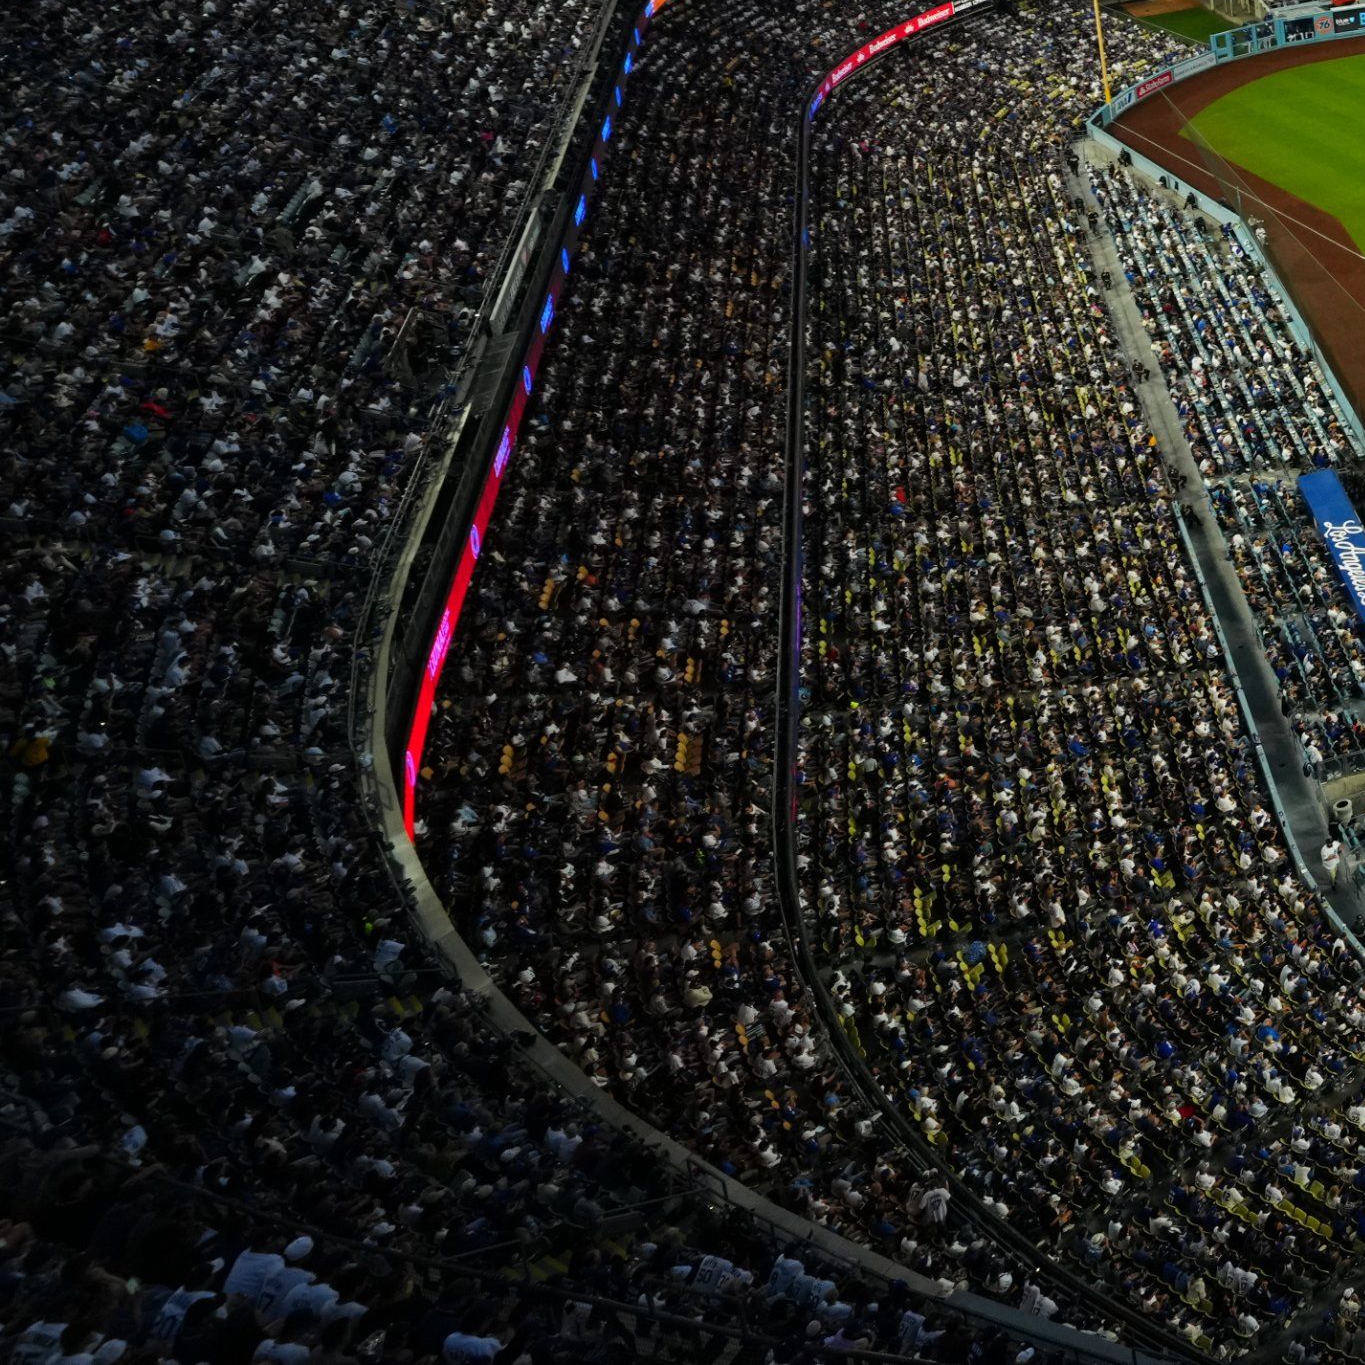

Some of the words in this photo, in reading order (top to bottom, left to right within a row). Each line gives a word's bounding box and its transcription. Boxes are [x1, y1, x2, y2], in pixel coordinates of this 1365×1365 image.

[918, 8, 950, 28] Budweiser
[1318, 18, 1331, 29] 76
[869, 34, 897, 54] Budweiser
[1323, 519, 1363, 551] Los
